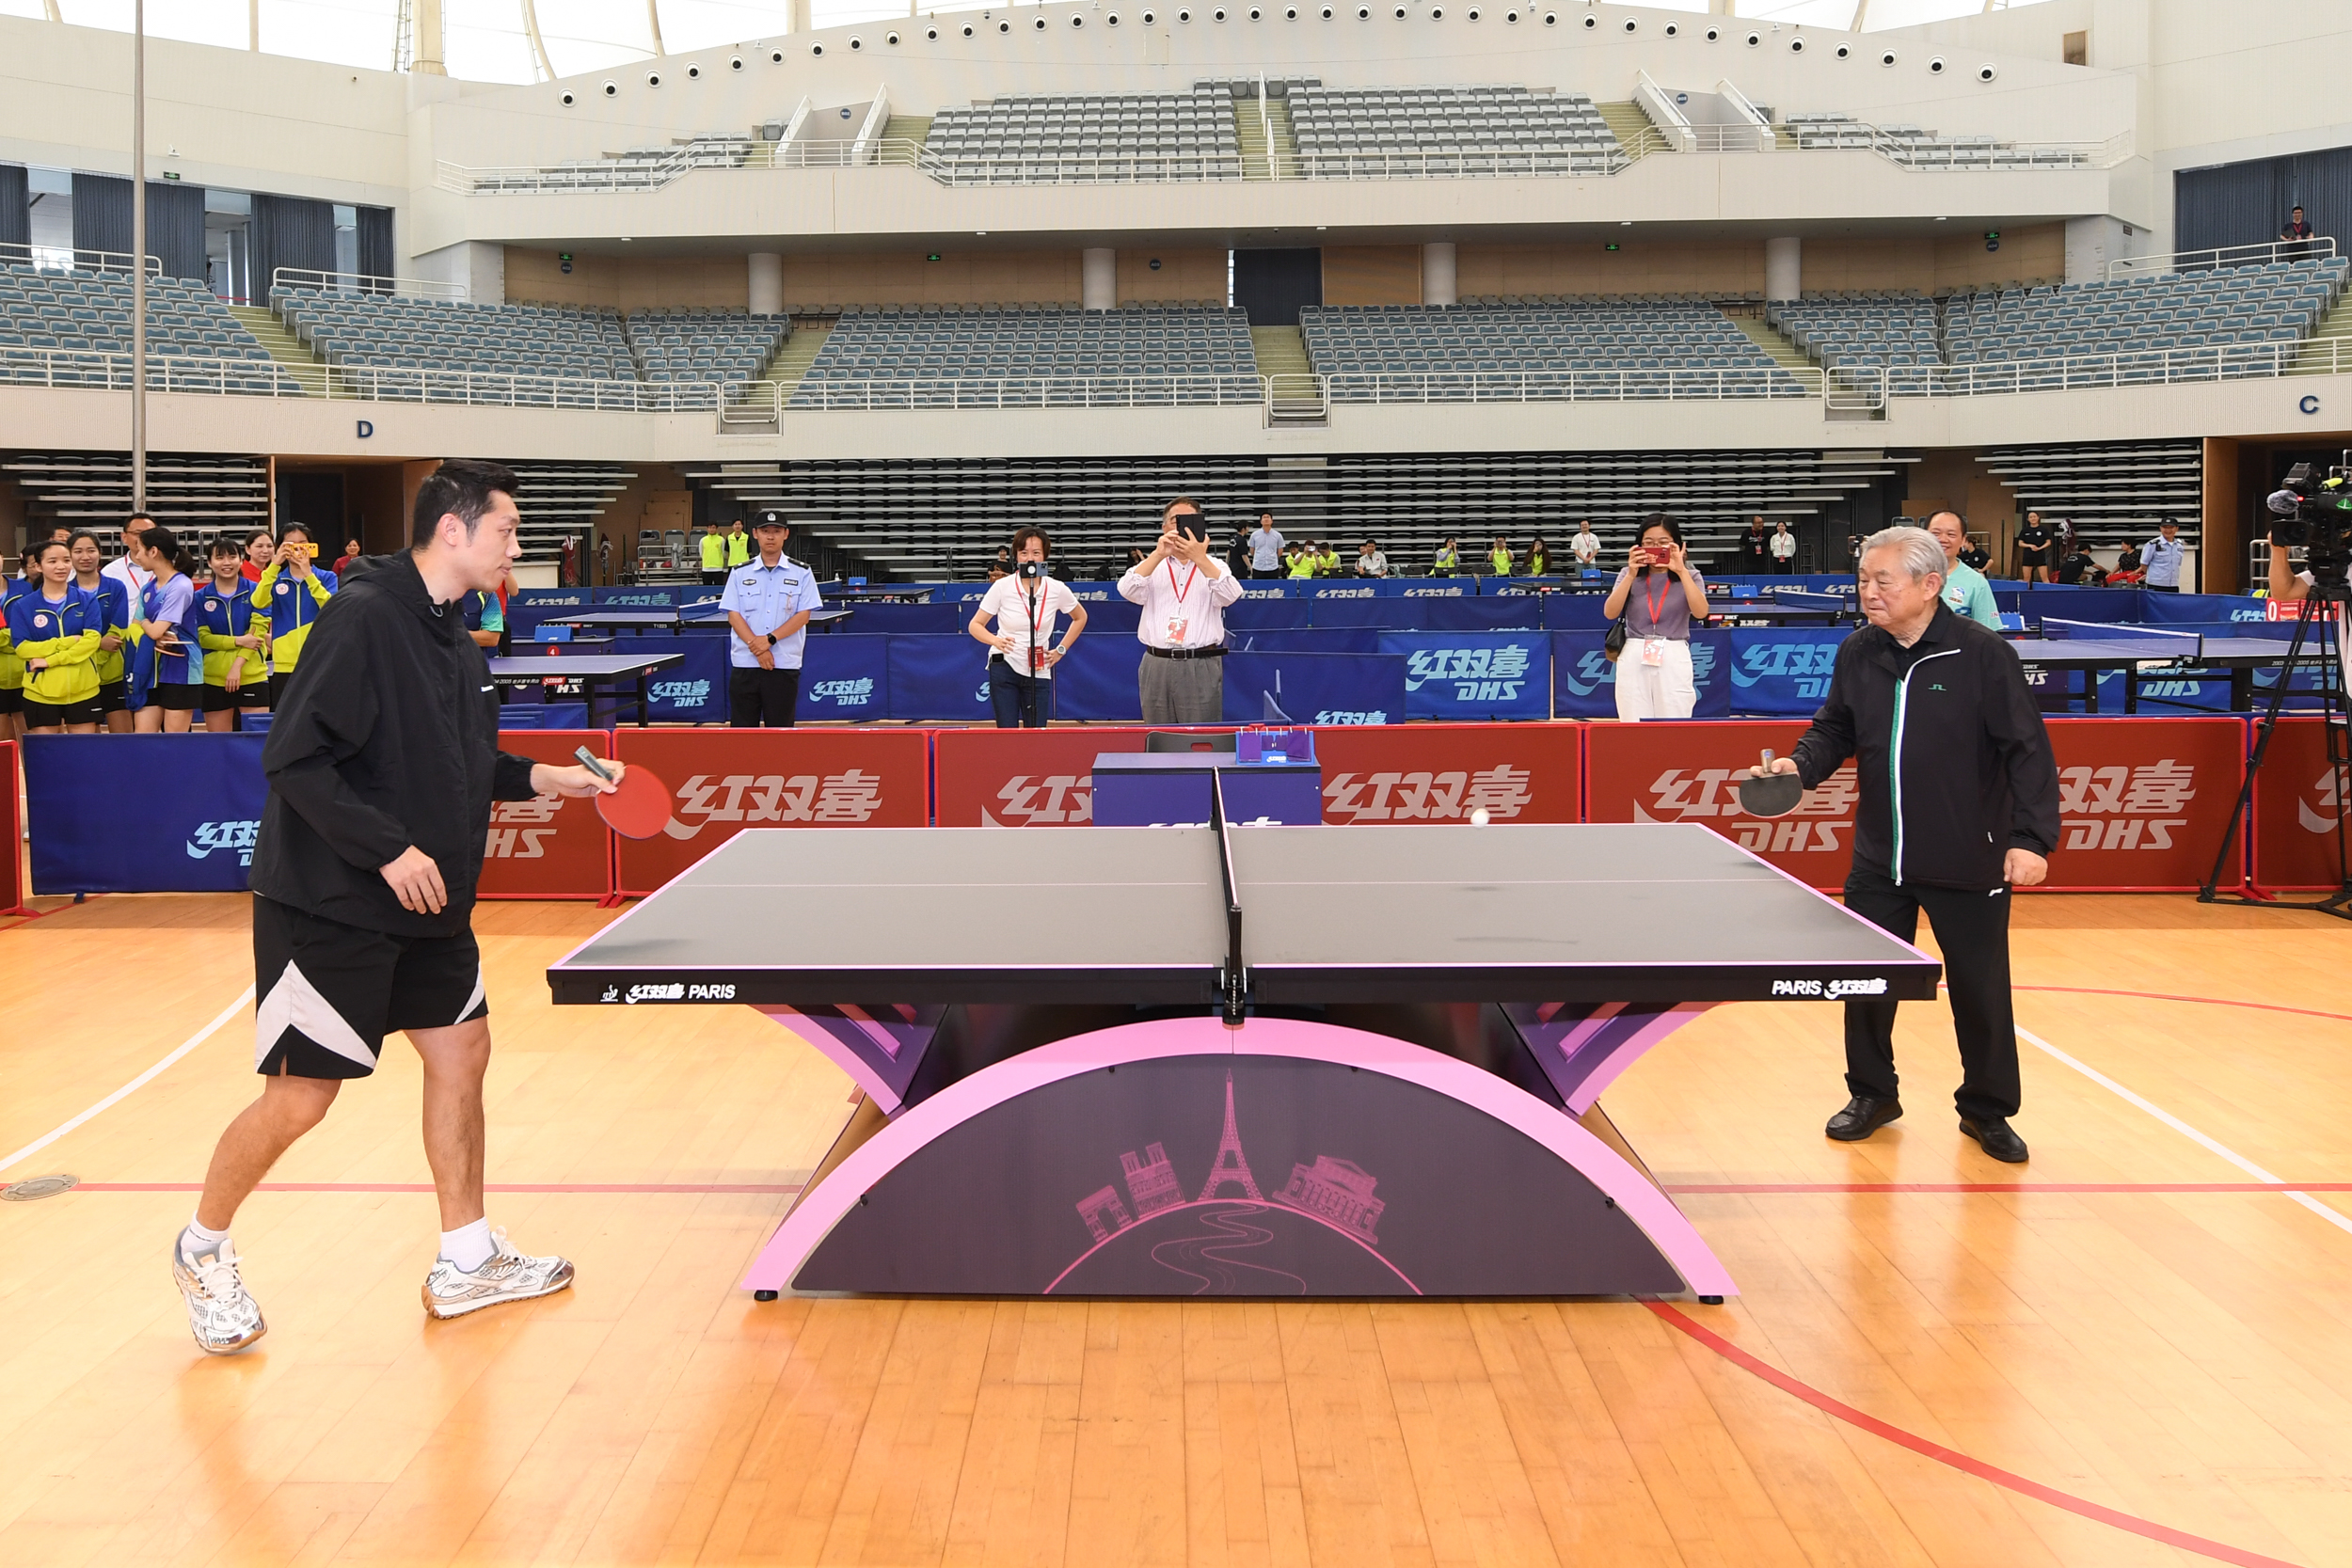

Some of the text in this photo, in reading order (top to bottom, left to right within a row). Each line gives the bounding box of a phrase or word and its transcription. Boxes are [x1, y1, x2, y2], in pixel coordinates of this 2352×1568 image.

[2298, 395, 2320, 415] C
[357, 420, 373, 438] D
[1406, 644, 1530, 691] 红双喜
[1567, 641, 1717, 696] 红喜
[647, 679, 710, 703] 红双喜
[674, 696, 708, 706] DHS
[809, 677, 874, 702] 红双喜
[836, 694, 871, 705] DHS
[1454, 681, 1525, 700] DHS
[664, 768, 882, 840] 红双喜
[1322, 764, 1533, 826] 红双喜
[1634, 767, 1861, 823] 红喜
[1730, 821, 1853, 852] DHS
[2059, 819, 2187, 850] DHS
[626, 983, 685, 1005] 红双喜
[689, 984, 736, 999] PARIS
[1772, 977, 1887, 1000] PARIS 红双喜
